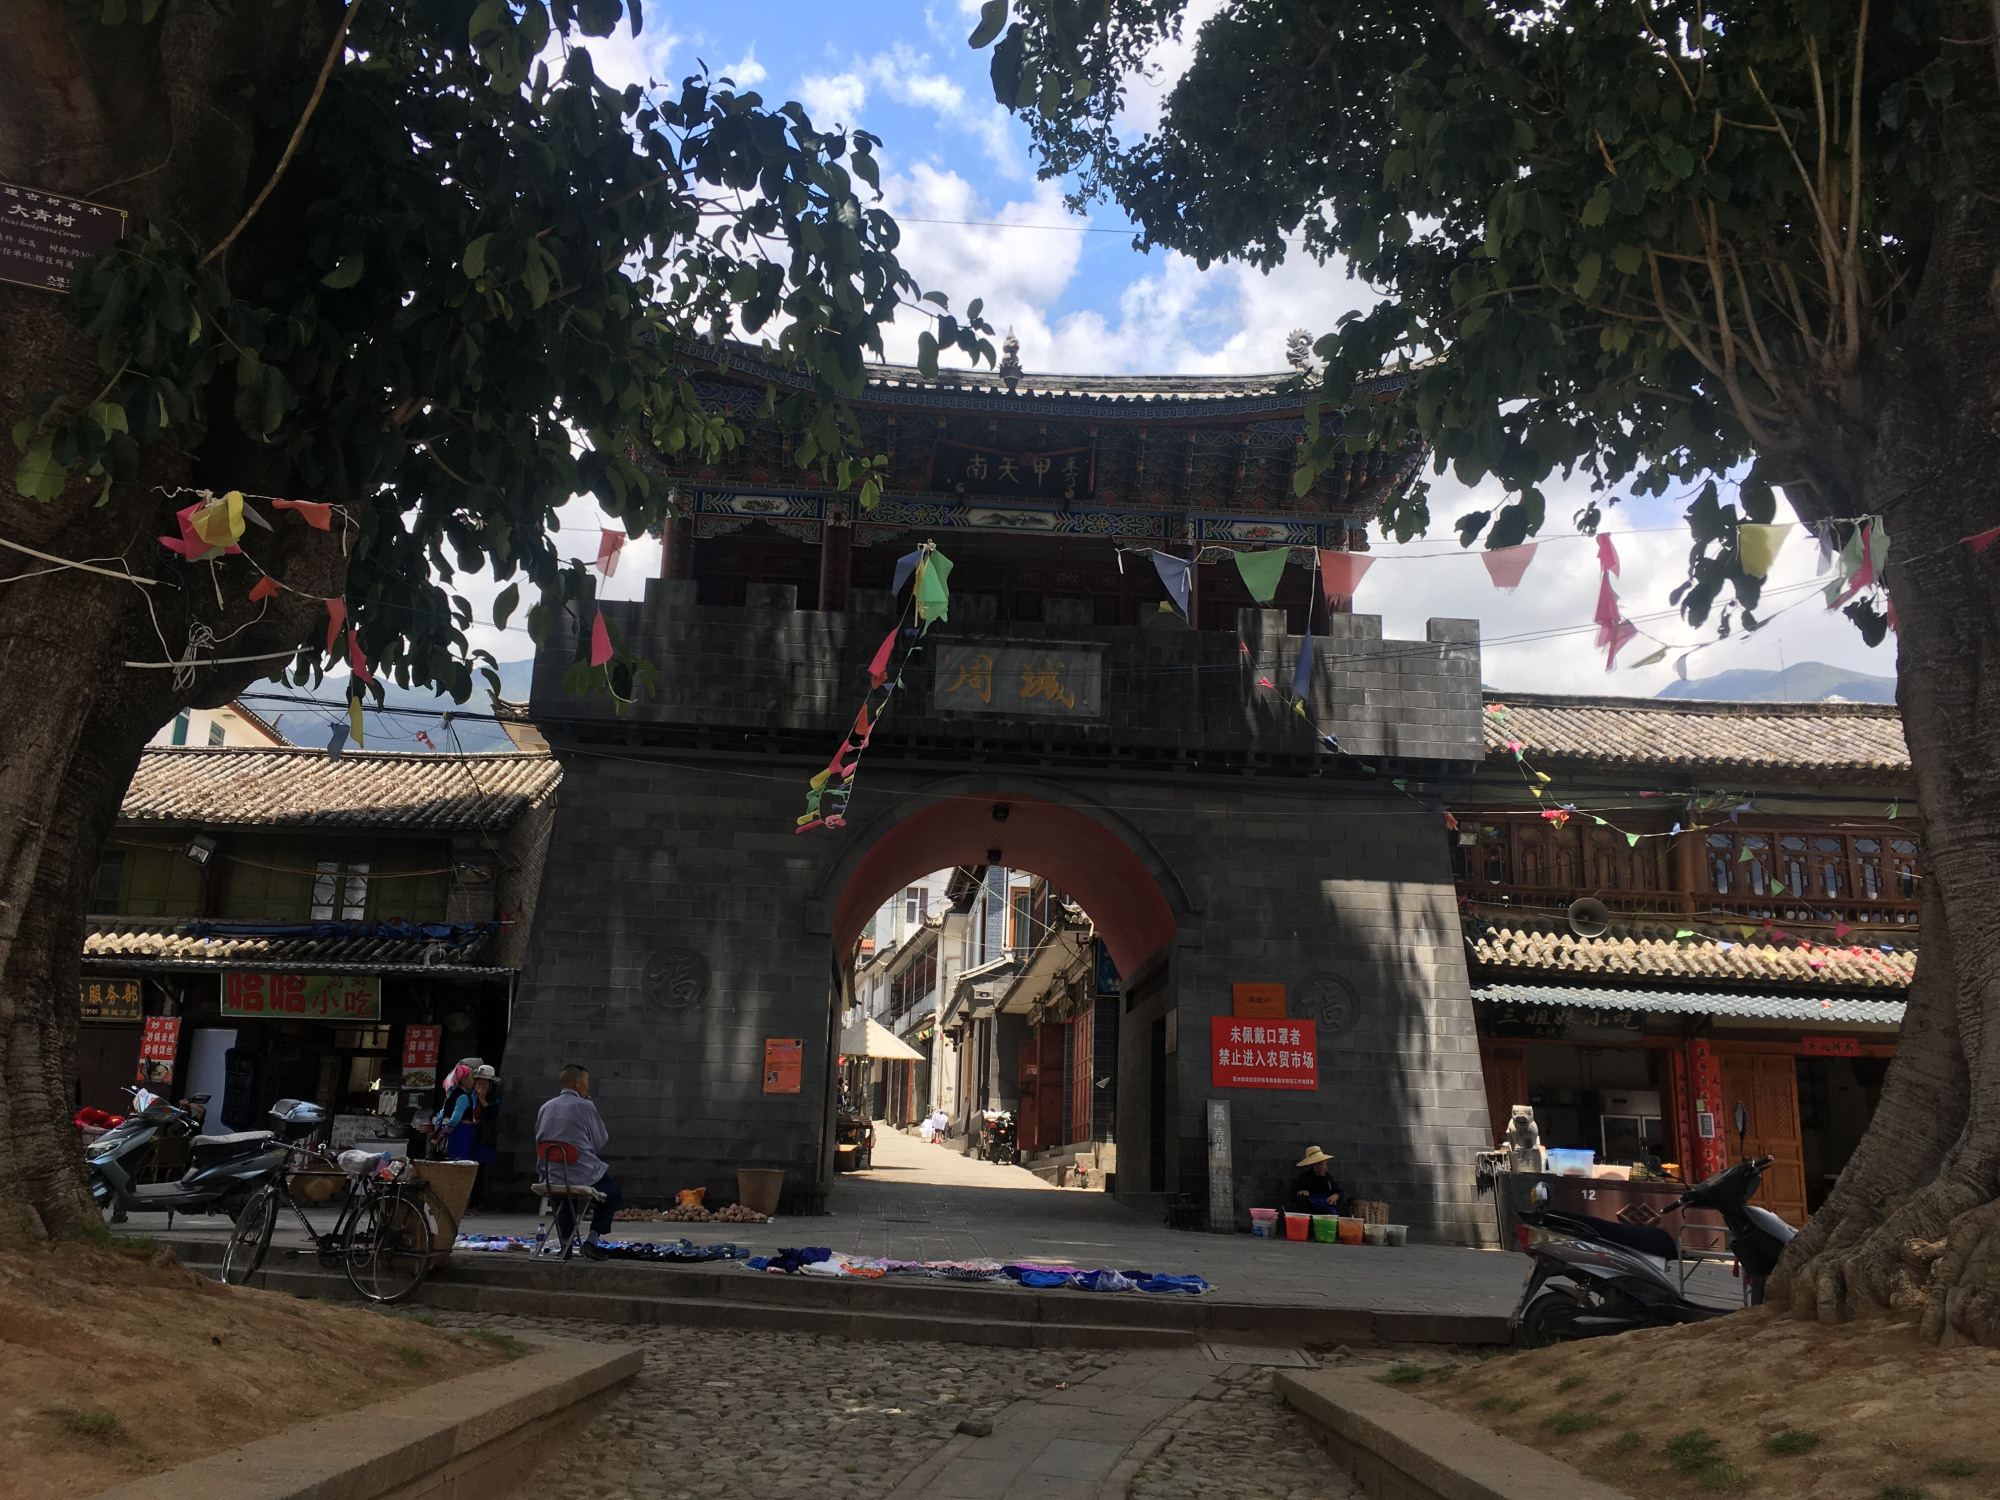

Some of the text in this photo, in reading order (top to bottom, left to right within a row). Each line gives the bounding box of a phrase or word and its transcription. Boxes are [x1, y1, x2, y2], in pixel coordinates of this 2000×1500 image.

[8, 203, 76, 227] 大青树
[58, 229, 82, 240] Corner
[944, 654, 1075, 709] 周城
[79, 982, 139, 1006] 服务部
[227, 973, 374, 1016] 哈哈小吃
[151, 1021, 174, 1030] 炒饭
[1497, 1008, 1640, 1030] 三姐妹小吃
[146, 1032, 175, 1043] 砂锅米线
[1230, 1025, 1301, 1046] 未佩戴口罩者
[144, 1044, 173, 1056] 砂锅饵丝
[408, 1040, 435, 1052] 麻辣烫
[407, 1053, 433, 1064] 奶茶
[1219, 1048, 1314, 1069] 禁止进入农贸市场
[1581, 1189, 1597, 1200] 12
